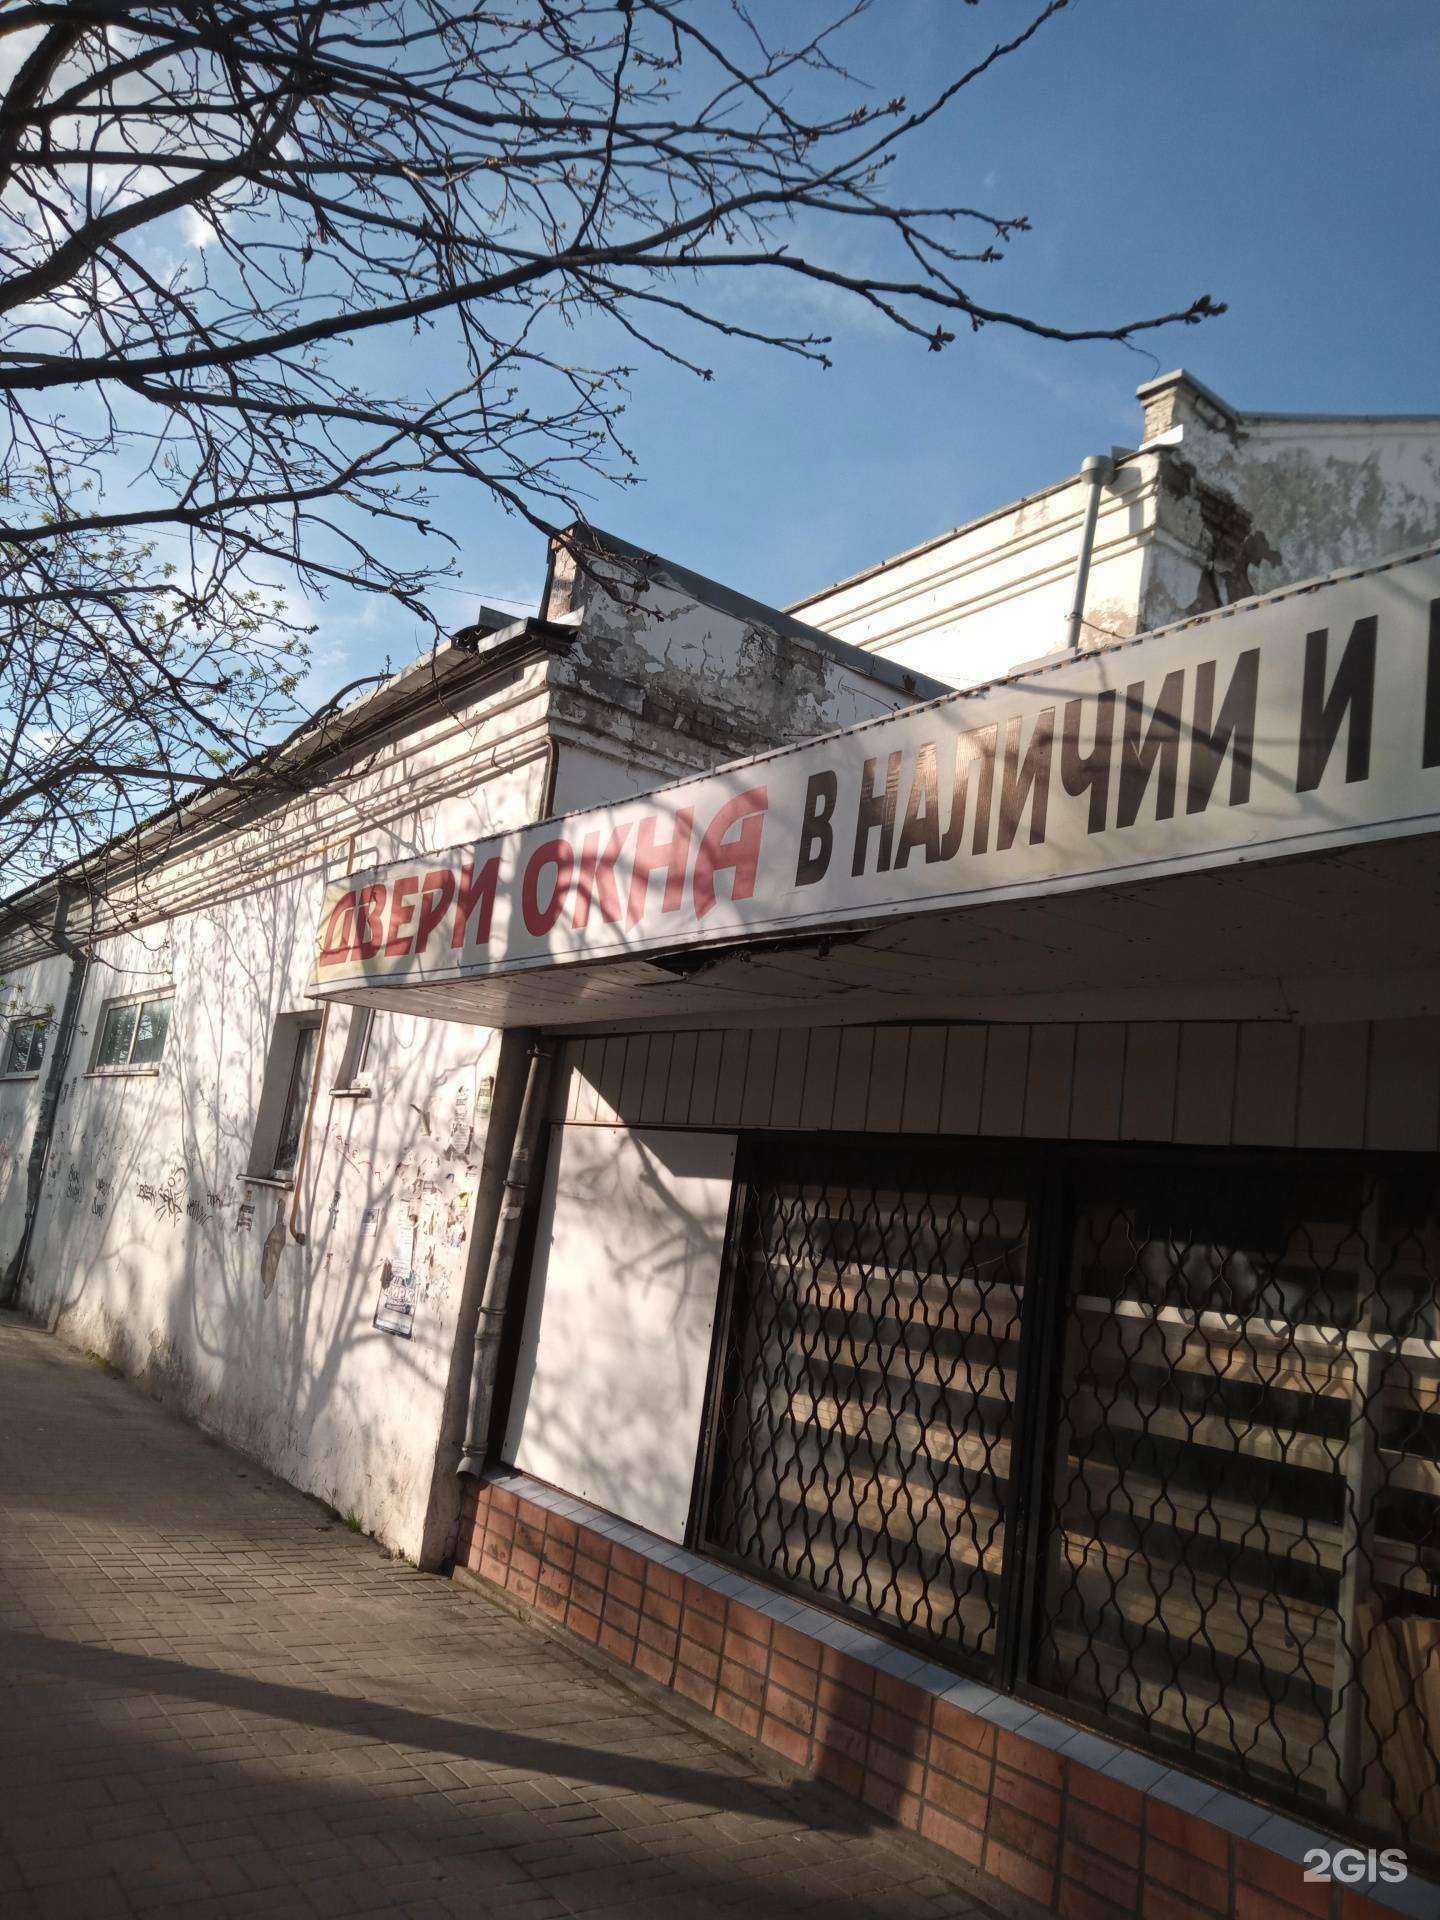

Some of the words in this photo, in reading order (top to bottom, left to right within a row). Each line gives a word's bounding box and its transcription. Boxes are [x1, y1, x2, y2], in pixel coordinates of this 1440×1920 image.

[320, 856, 500, 967] ДВЕРИ
[522, 785, 769, 937] ОКНА
[794, 769, 838, 888] В
[851, 648, 1261, 878] НАЛИЧИИ
[1296, 614, 1379, 794] И
